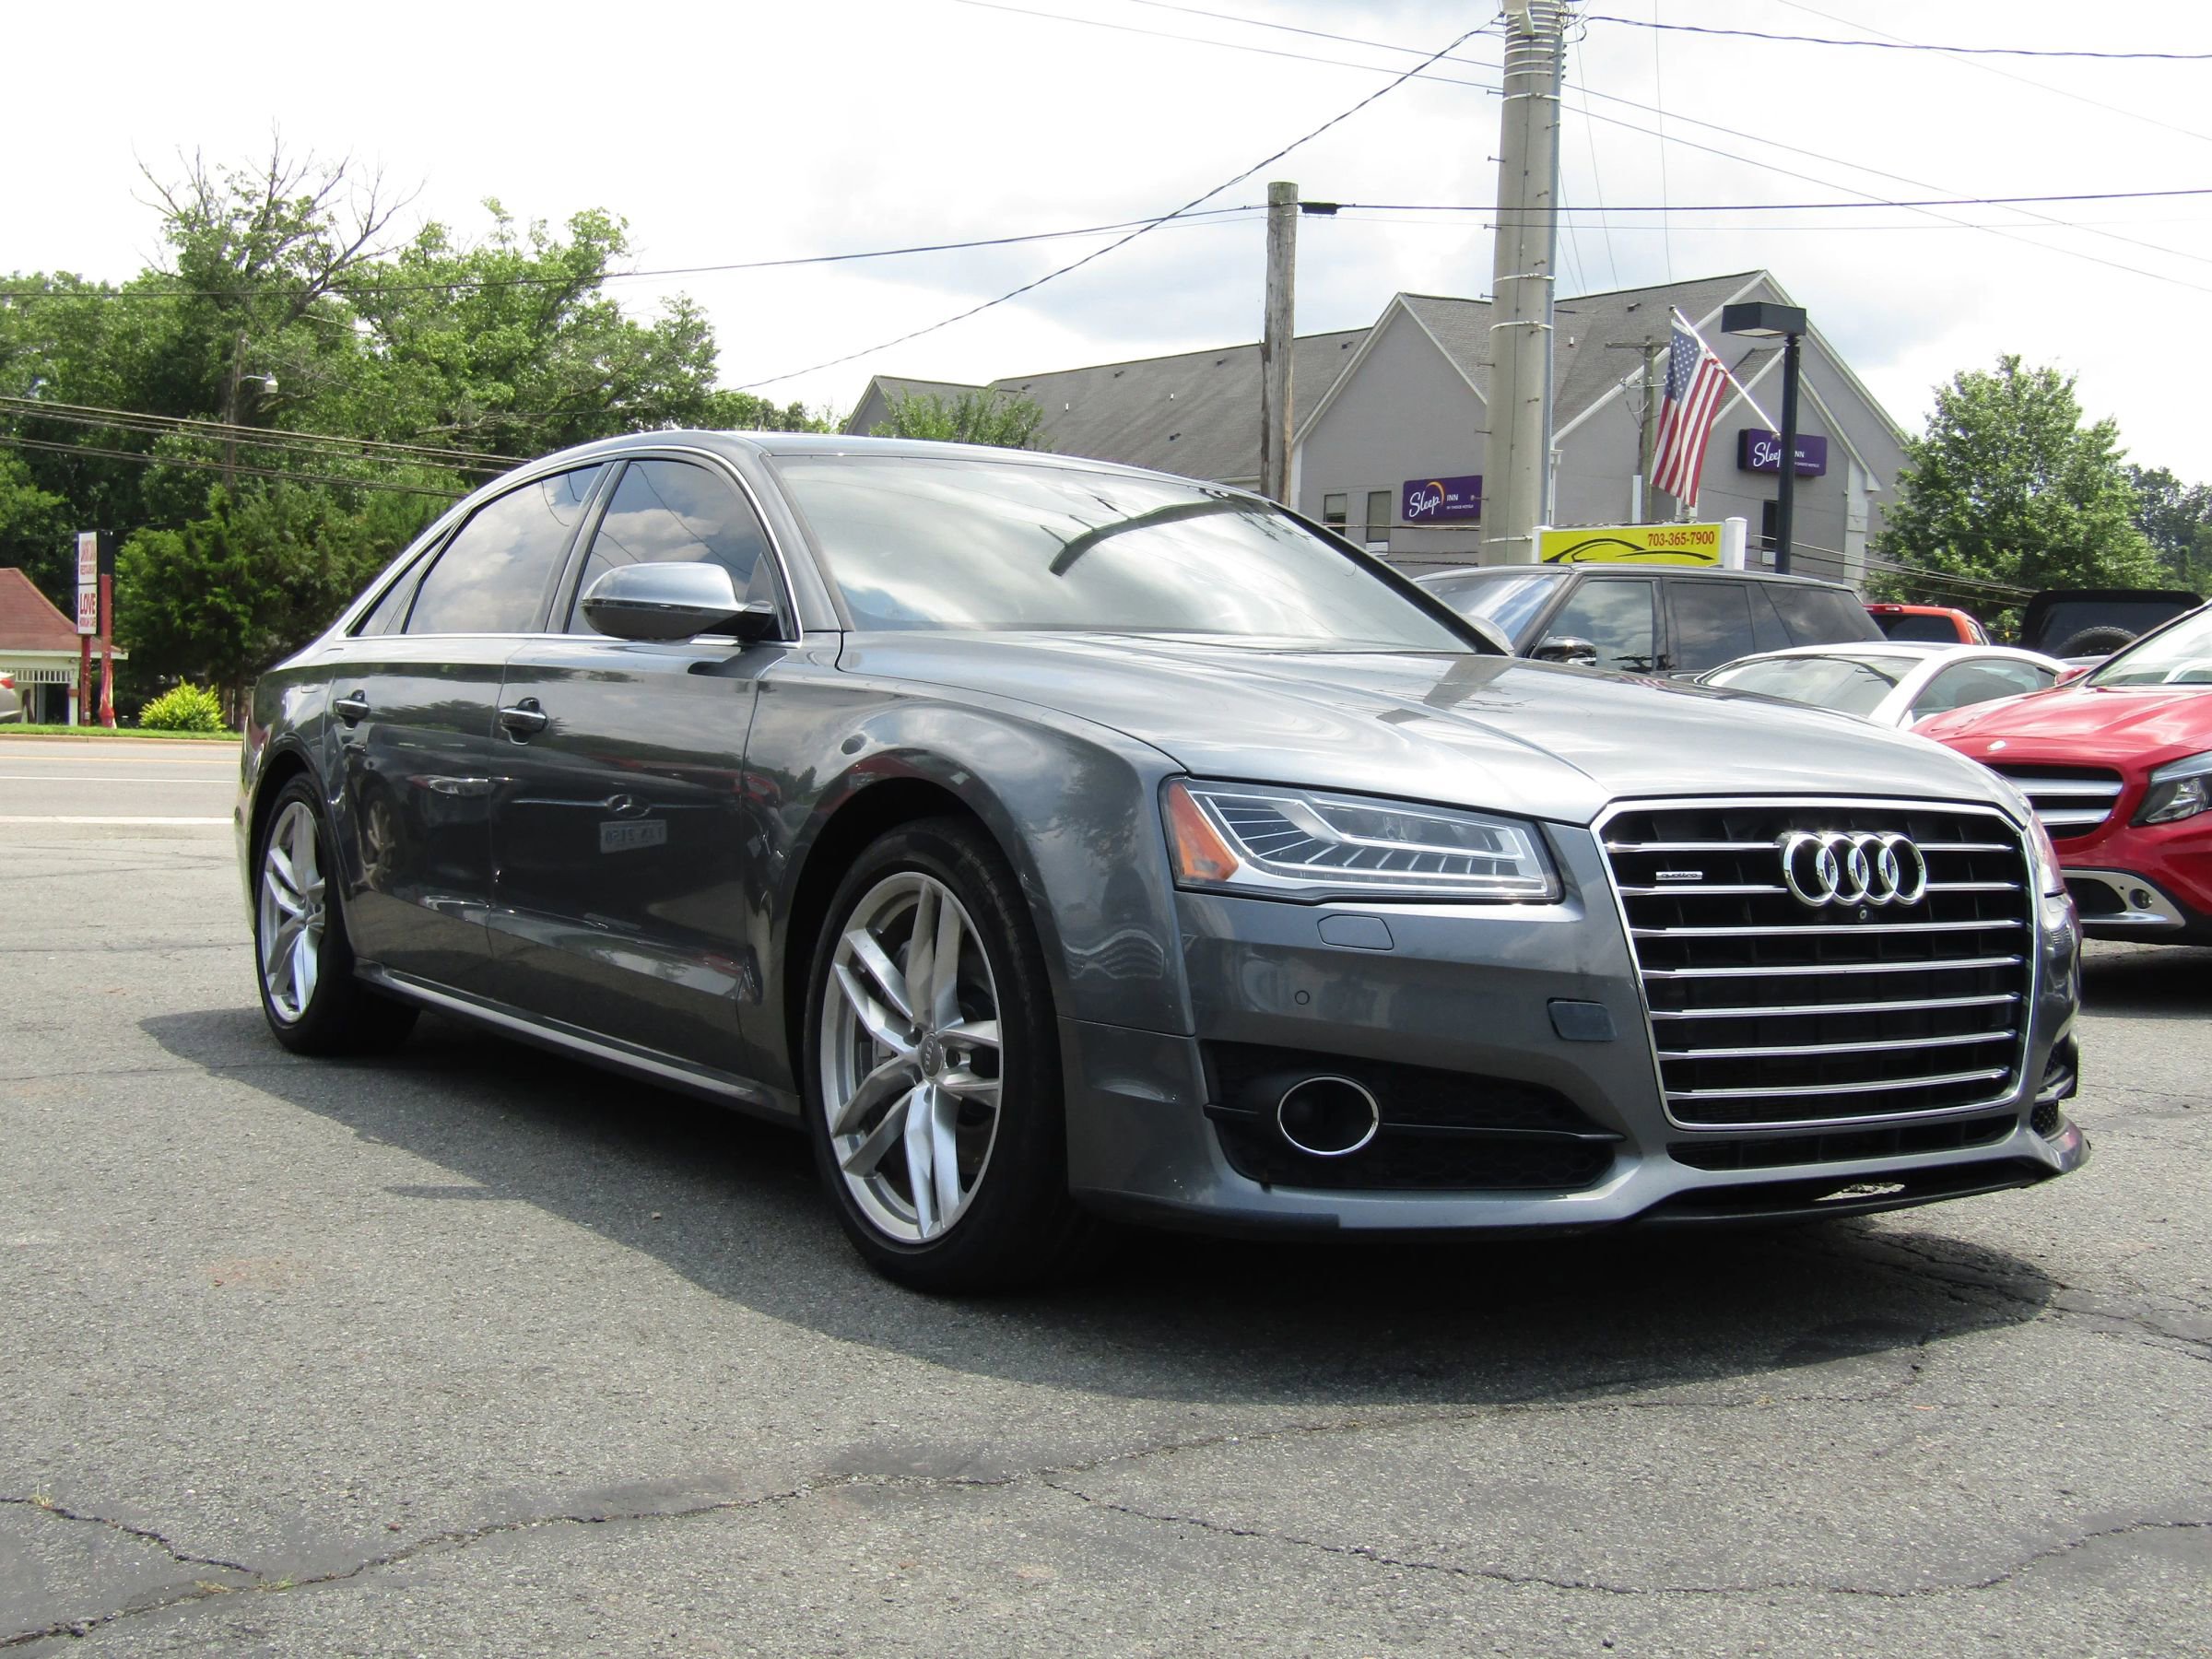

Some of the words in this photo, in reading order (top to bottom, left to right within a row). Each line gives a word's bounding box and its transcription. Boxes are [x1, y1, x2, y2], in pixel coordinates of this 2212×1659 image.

[1408, 490, 1441, 518] Sleep
[1648, 530, 1715, 547] 703-365-7900
[79, 593, 96, 615] LOVE
